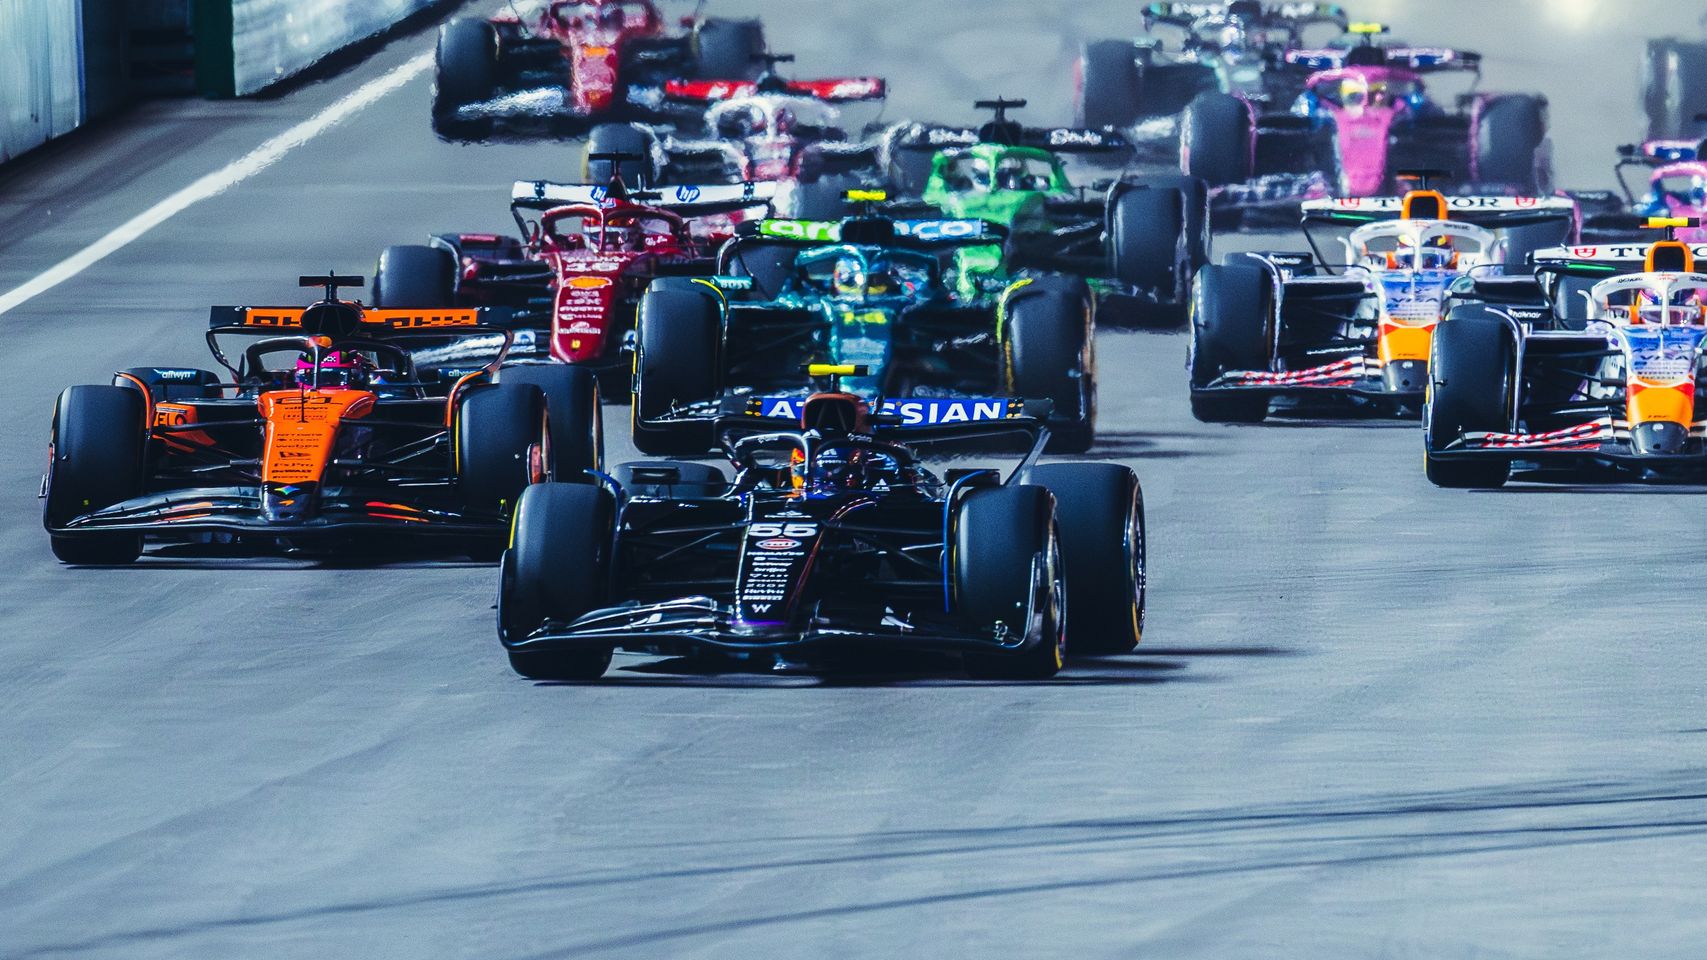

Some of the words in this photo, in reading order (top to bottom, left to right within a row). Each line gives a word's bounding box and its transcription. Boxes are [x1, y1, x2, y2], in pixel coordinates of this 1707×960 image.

[679, 185, 699, 203] hp
[1374, 198, 1500, 208] TOR
[769, 220, 973, 239] arco
[161, 370, 191, 380] allwyn
[153, 411, 187, 427] ELO
[769, 401, 1001, 424] ASSIAN
[748, 523, 818, 537] 55
